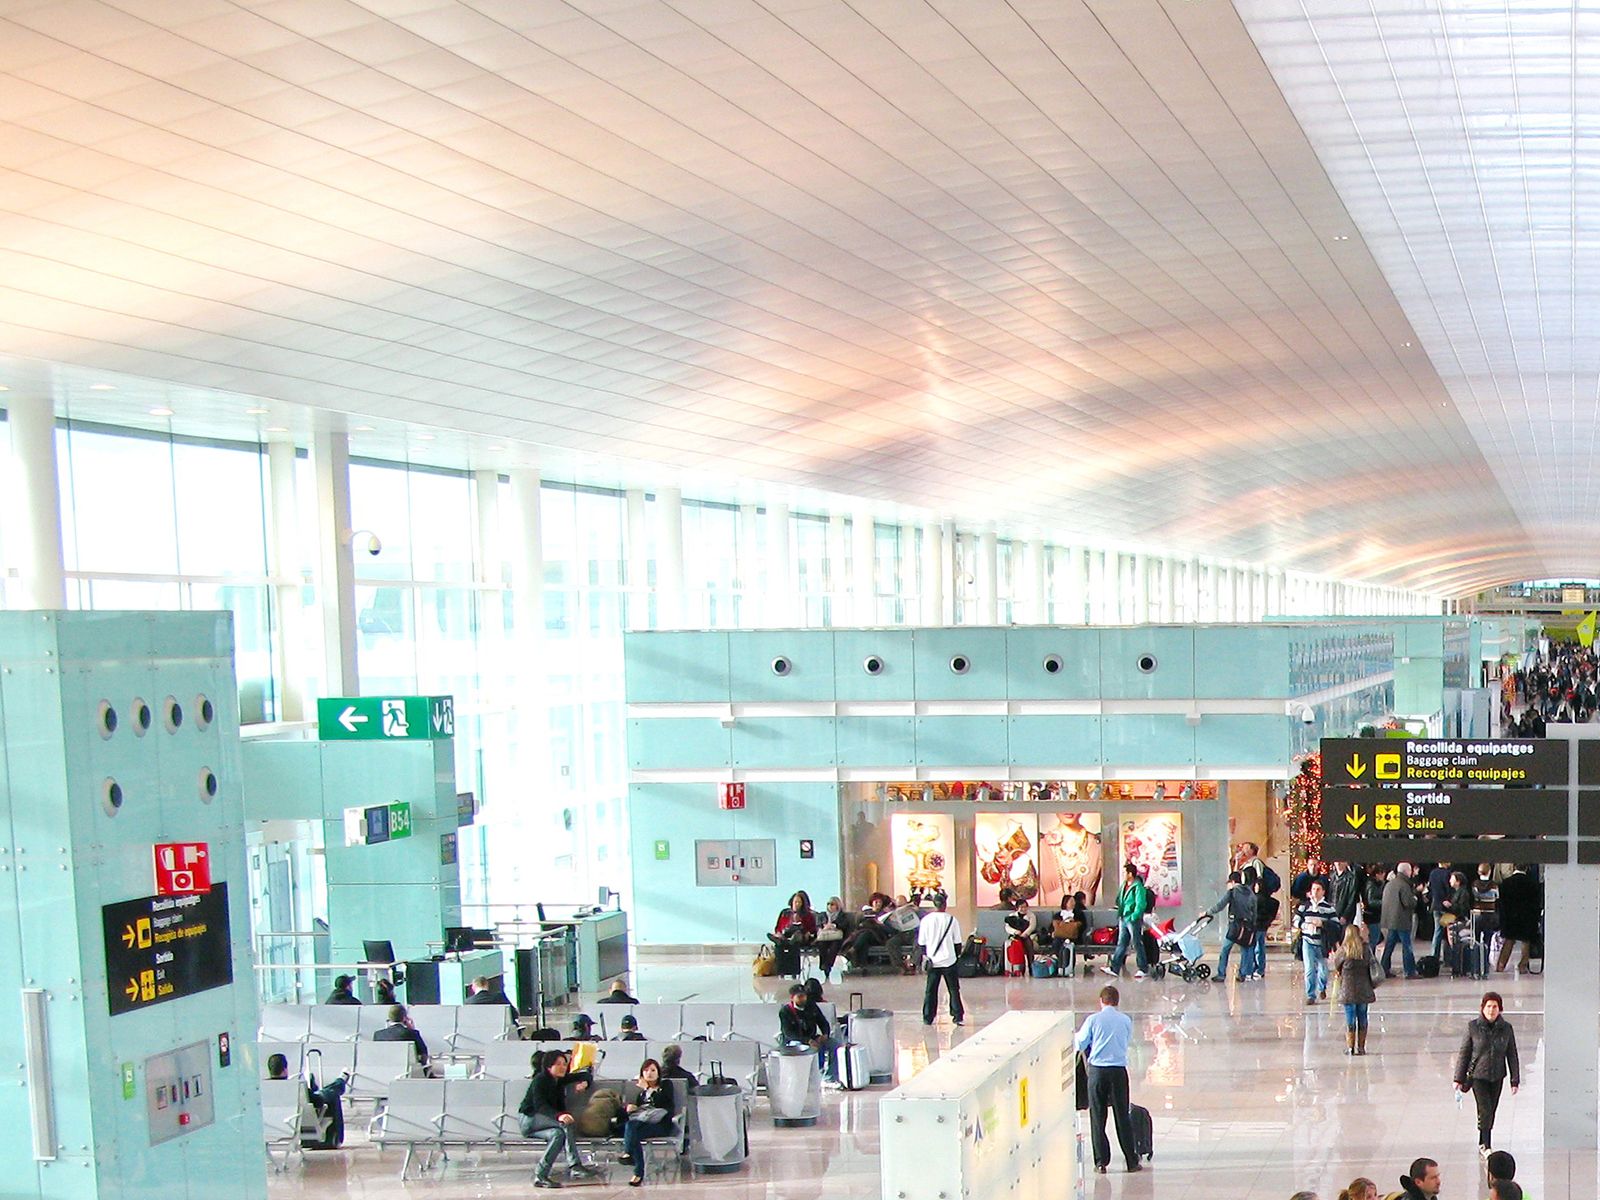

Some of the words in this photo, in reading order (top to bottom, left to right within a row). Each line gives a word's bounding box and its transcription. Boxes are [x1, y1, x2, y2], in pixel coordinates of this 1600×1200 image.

[1406, 742, 1463, 754] Recollida
[1467, 742, 1534, 756] equipatges
[1406, 756, 1450, 768] Baggage
[1451, 755, 1478, 766] claim
[1406, 767, 1463, 780] Recogida
[1467, 768, 1526, 781] equipajes
[1406, 793, 1451, 804] Sortida
[1406, 806, 1425, 816] Exit
[390, 809, 410, 832] B54
[1406, 818, 1444, 829] Salida
